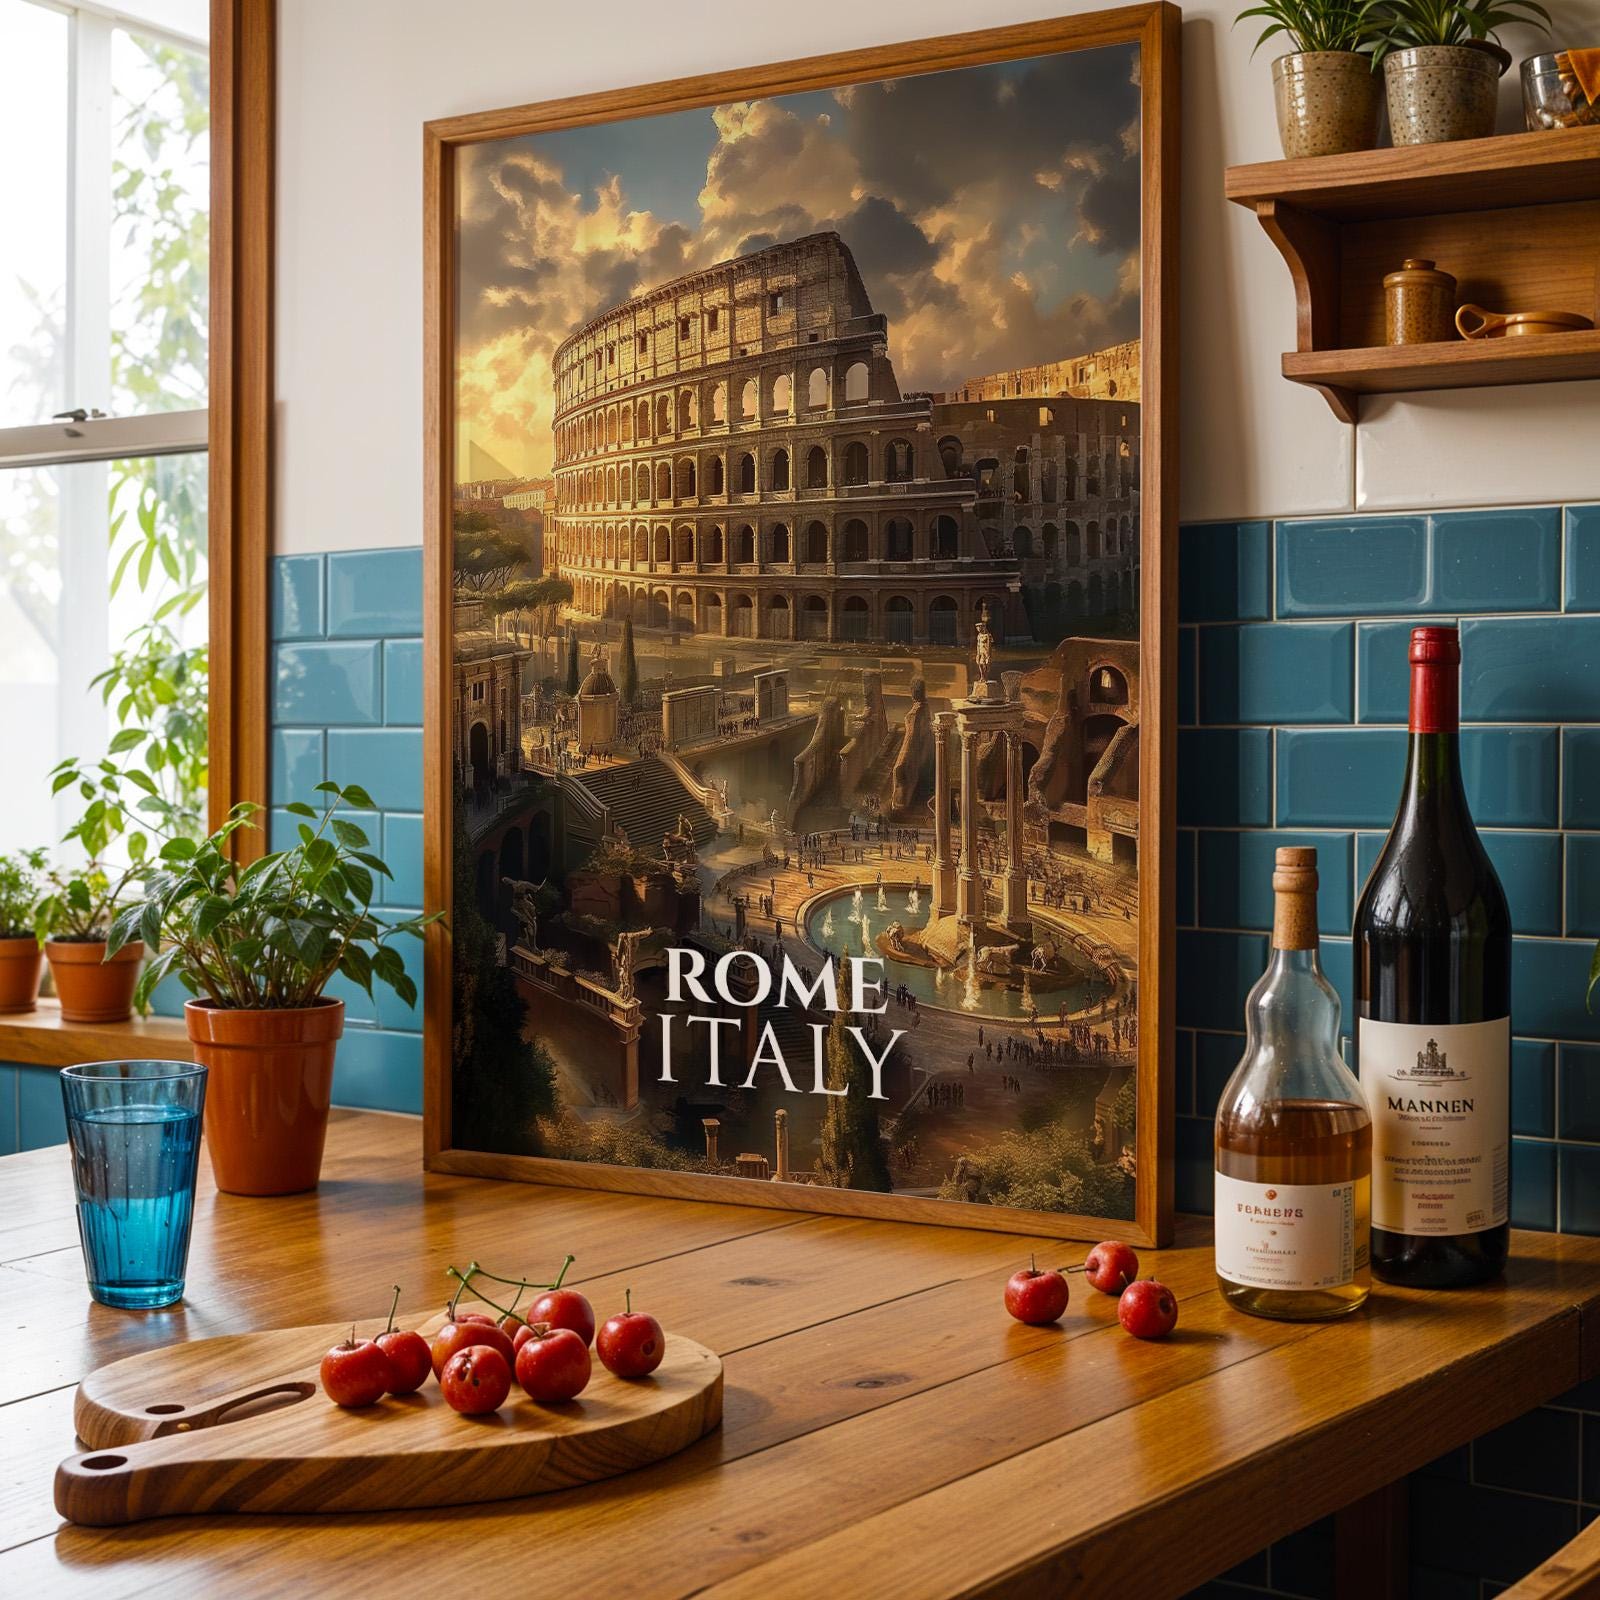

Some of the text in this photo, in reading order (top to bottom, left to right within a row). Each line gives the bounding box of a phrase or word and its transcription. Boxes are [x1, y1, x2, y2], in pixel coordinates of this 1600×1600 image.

[664, 947, 889, 1014] ROME
[656, 1013, 908, 1100] ITALY
[1388, 1096, 1475, 1113] MANNEN
